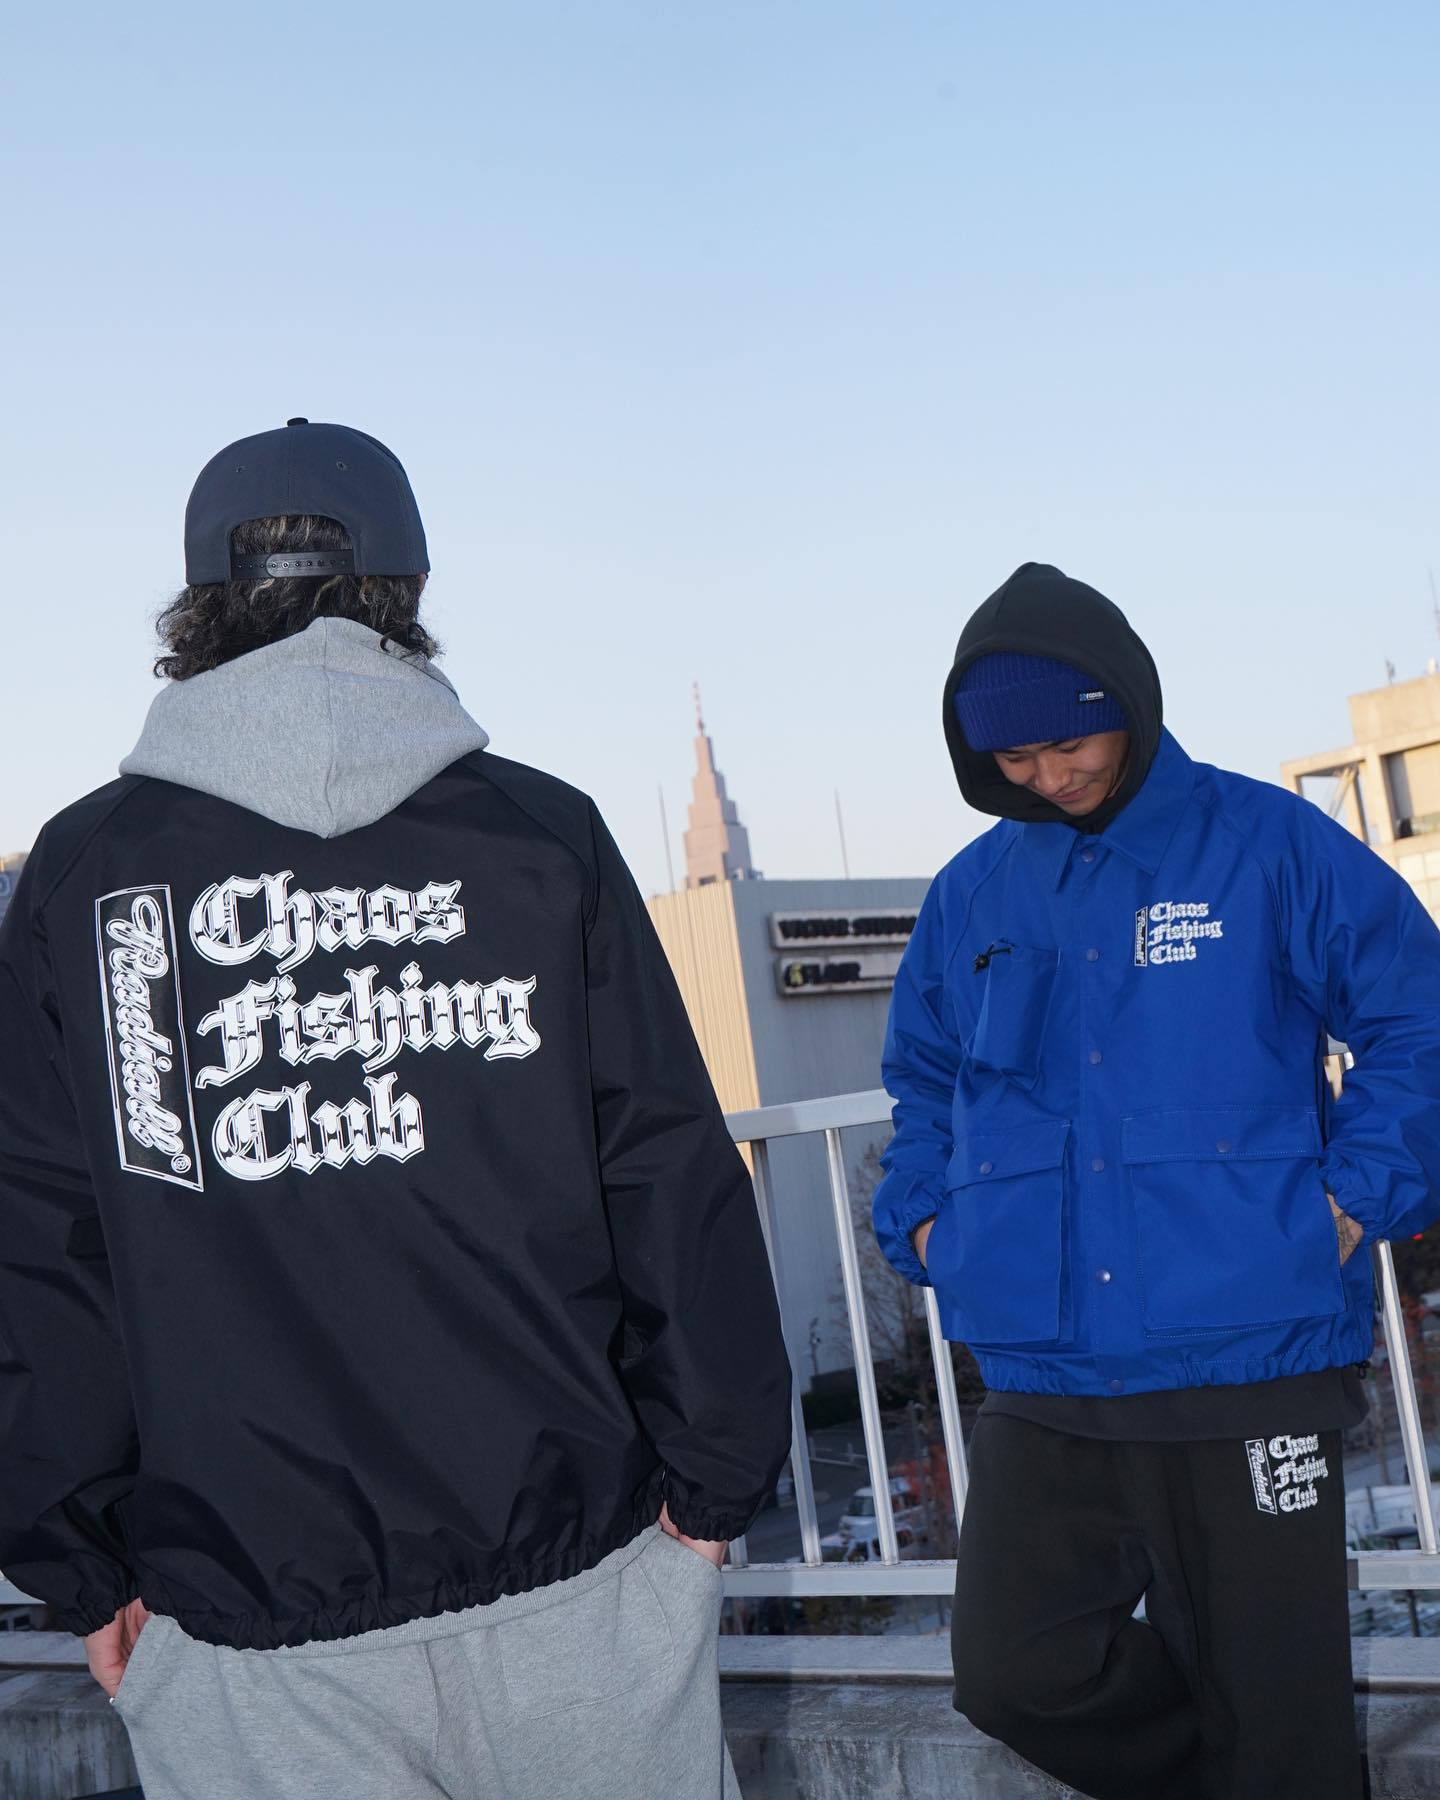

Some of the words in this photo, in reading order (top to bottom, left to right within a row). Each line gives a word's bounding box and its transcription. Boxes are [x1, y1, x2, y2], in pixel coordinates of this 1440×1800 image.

[189, 870, 466, 974] Chaos
[1149, 901, 1209, 922] Chaos
[1147, 920, 1223, 946] Fishing
[1149, 941, 1197, 965] Club
[195, 961, 541, 1088] Fishing
[211, 1072, 425, 1181] Club
[1268, 1434, 1319, 1460] Chaos
[1274, 1456, 1329, 1490] Fishing
[1279, 1483, 1318, 1513] Club
